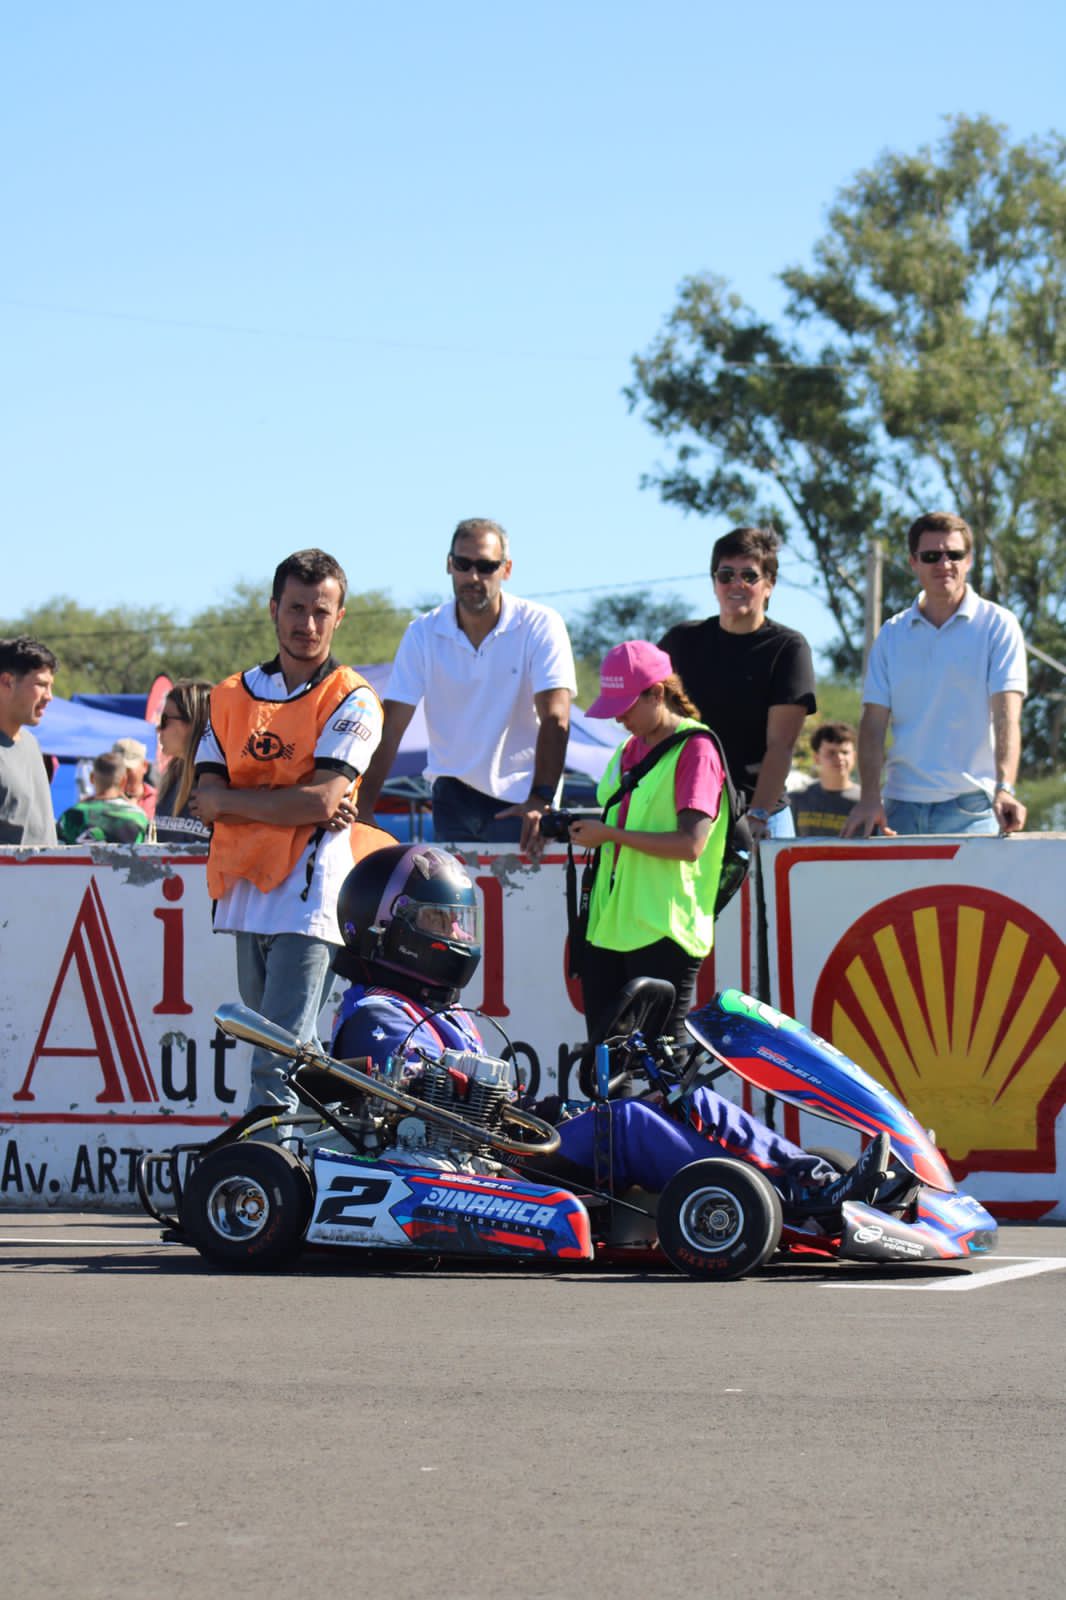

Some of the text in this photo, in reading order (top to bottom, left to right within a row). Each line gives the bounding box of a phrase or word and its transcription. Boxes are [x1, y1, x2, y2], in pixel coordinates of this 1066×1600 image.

[1, 1140, 60, 1193] Av.
[314, 1176, 392, 1227] 2
[421, 1187, 557, 1226] DINAMICA
